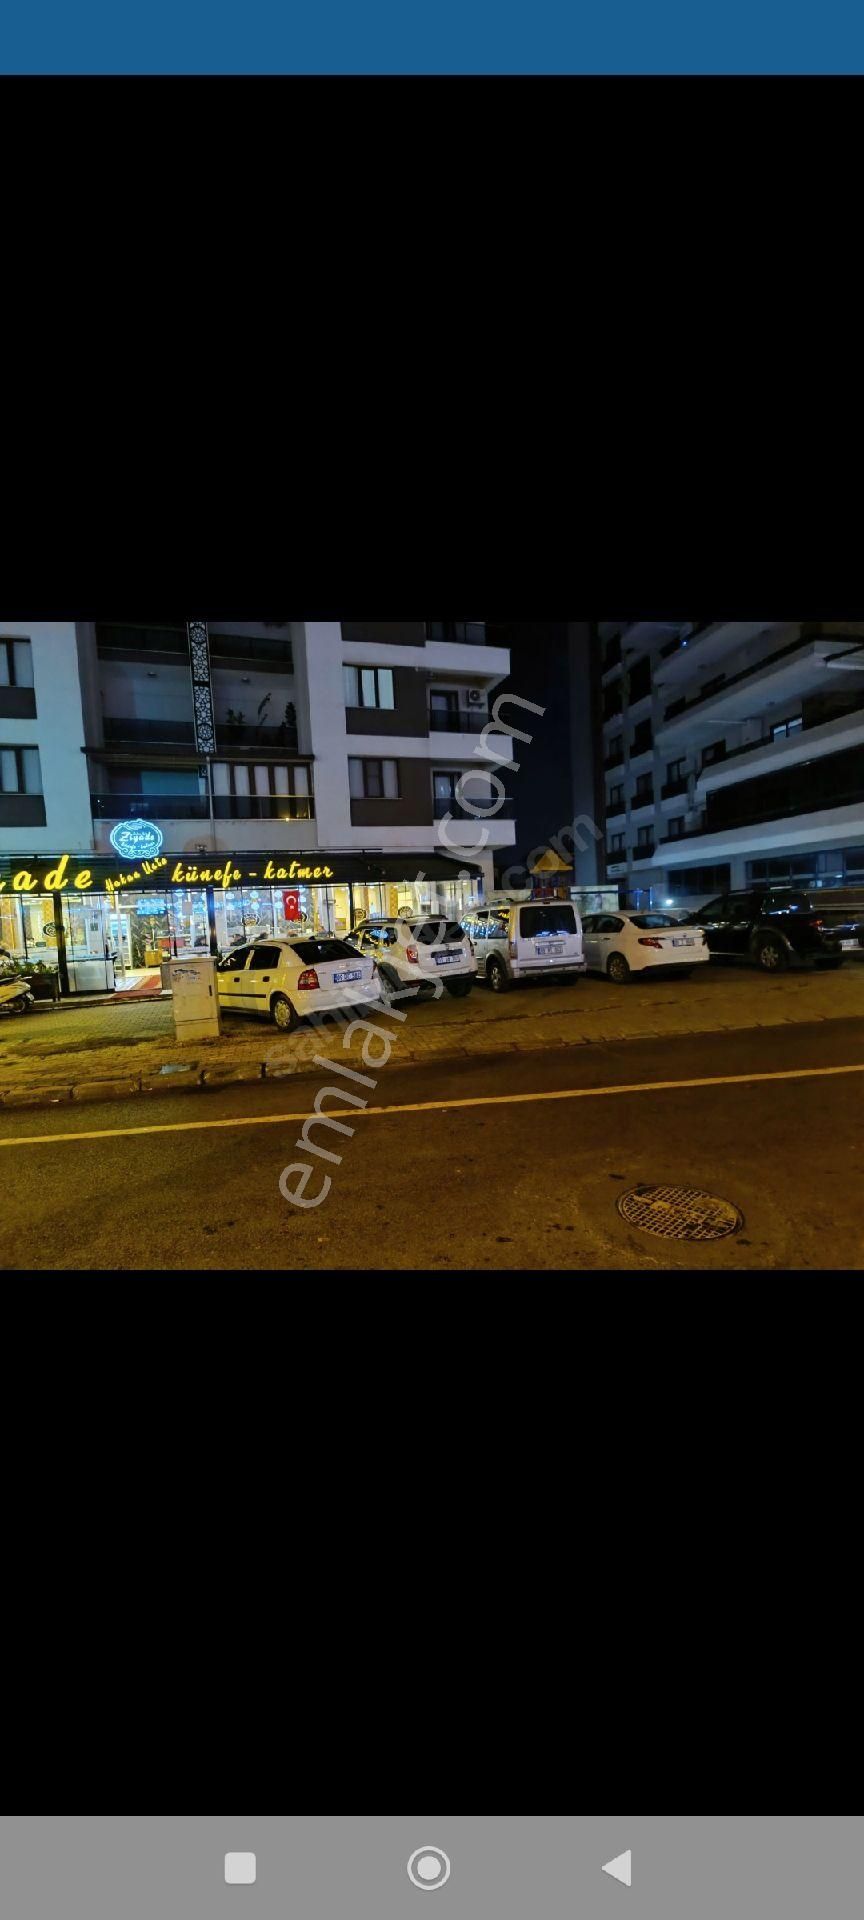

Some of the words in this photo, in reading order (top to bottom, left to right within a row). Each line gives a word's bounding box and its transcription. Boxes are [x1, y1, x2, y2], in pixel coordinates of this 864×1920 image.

[0, 854, 93, 891] ade
[171, 860, 242, 889] künefe
[263, 860, 334, 879] katmer
